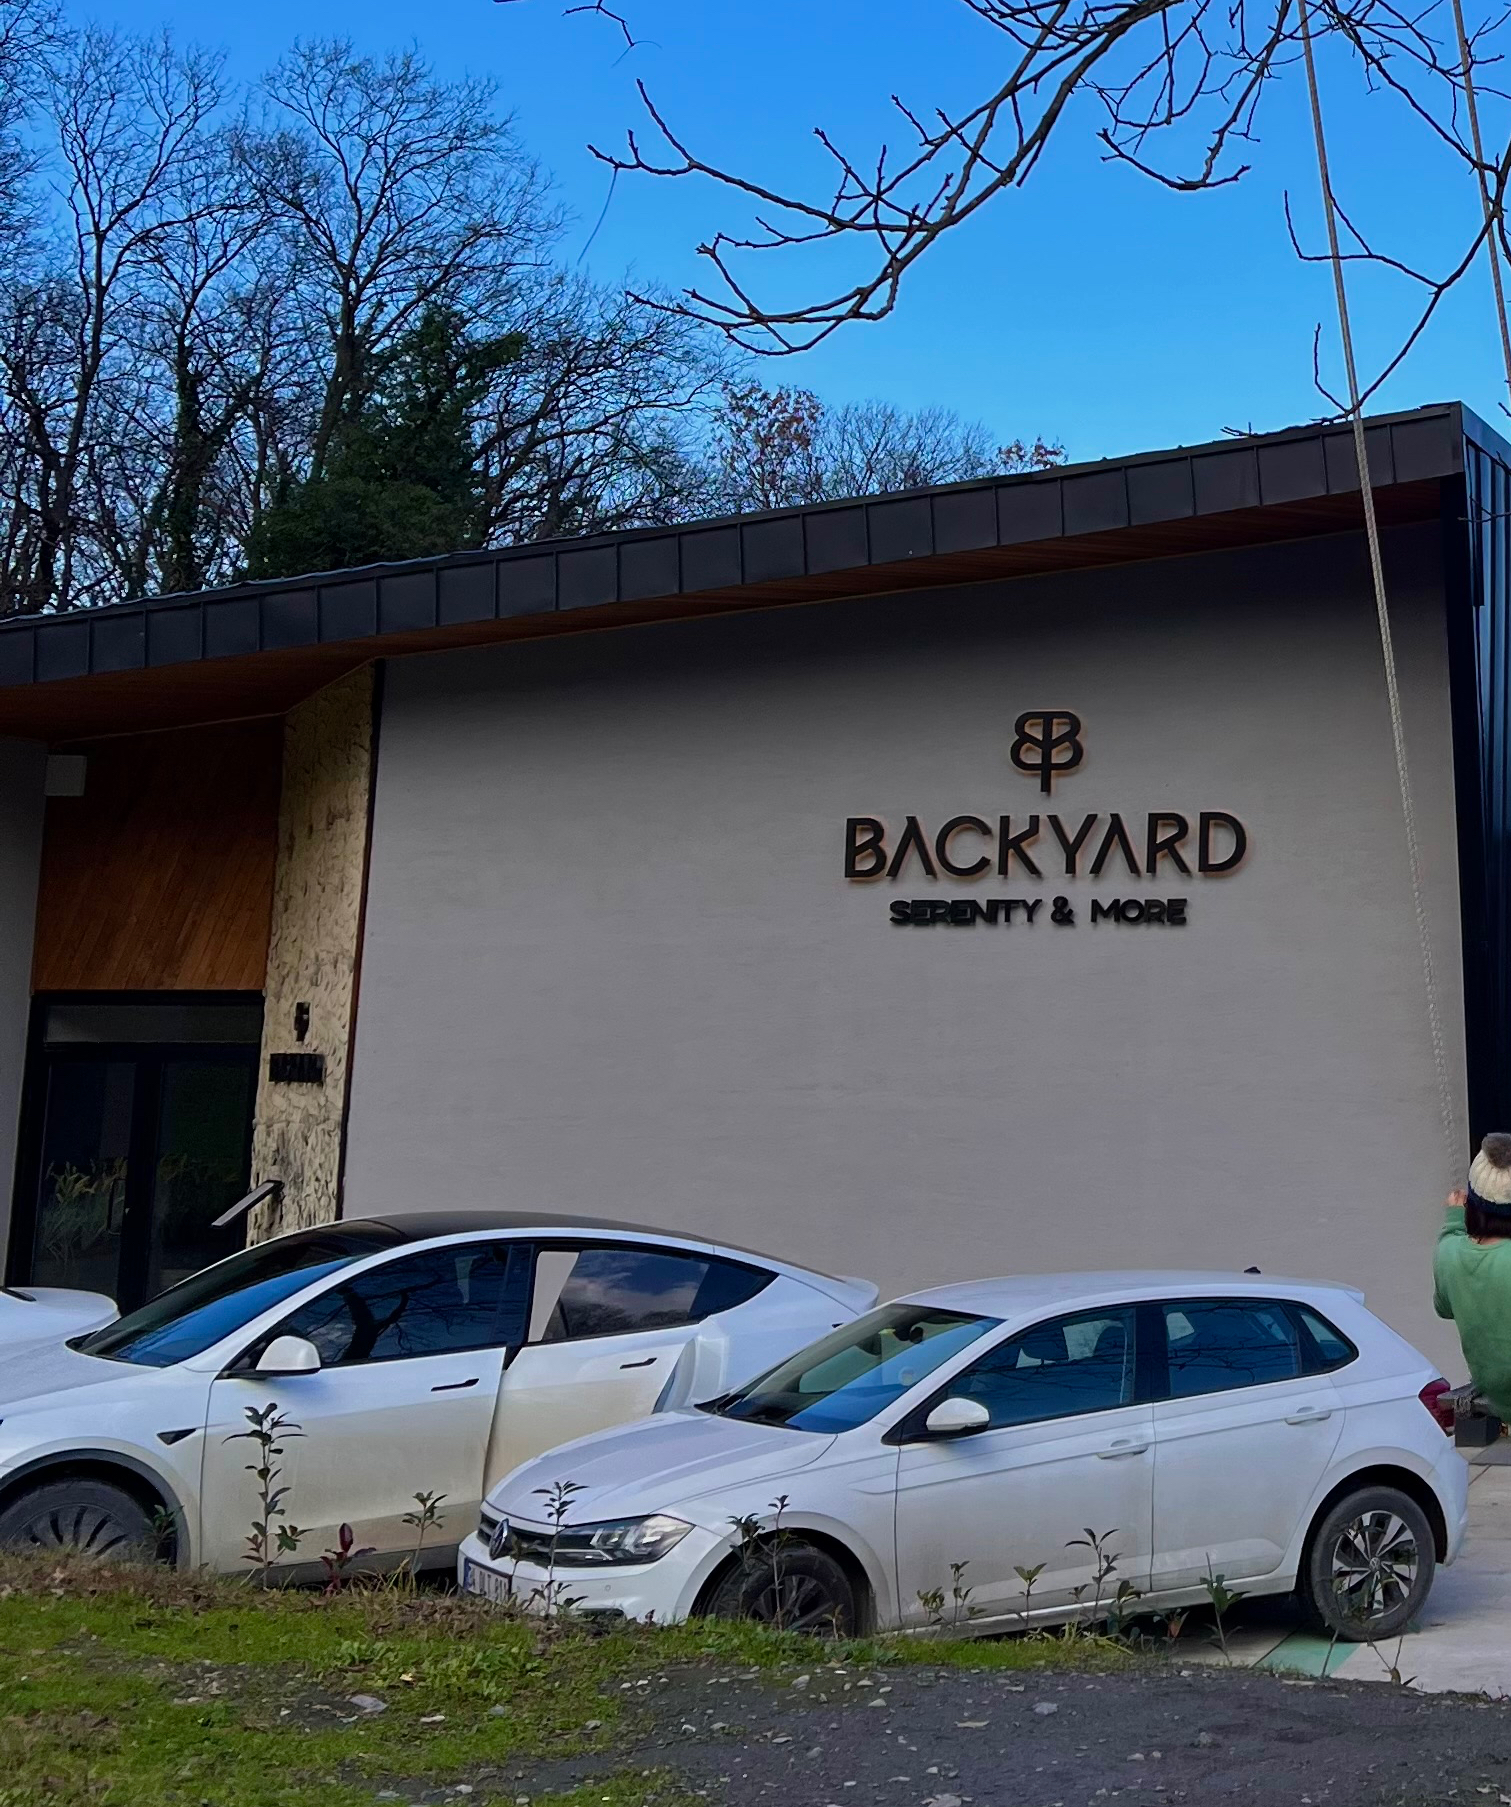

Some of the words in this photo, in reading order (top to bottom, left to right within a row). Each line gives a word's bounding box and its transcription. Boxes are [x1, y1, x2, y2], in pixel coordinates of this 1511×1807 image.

[844, 812, 1247, 878] BACKYARD
[889, 898, 1042, 925] SERENITY
[1051, 896, 1074, 925] &
[1090, 898, 1187, 924] MORE
